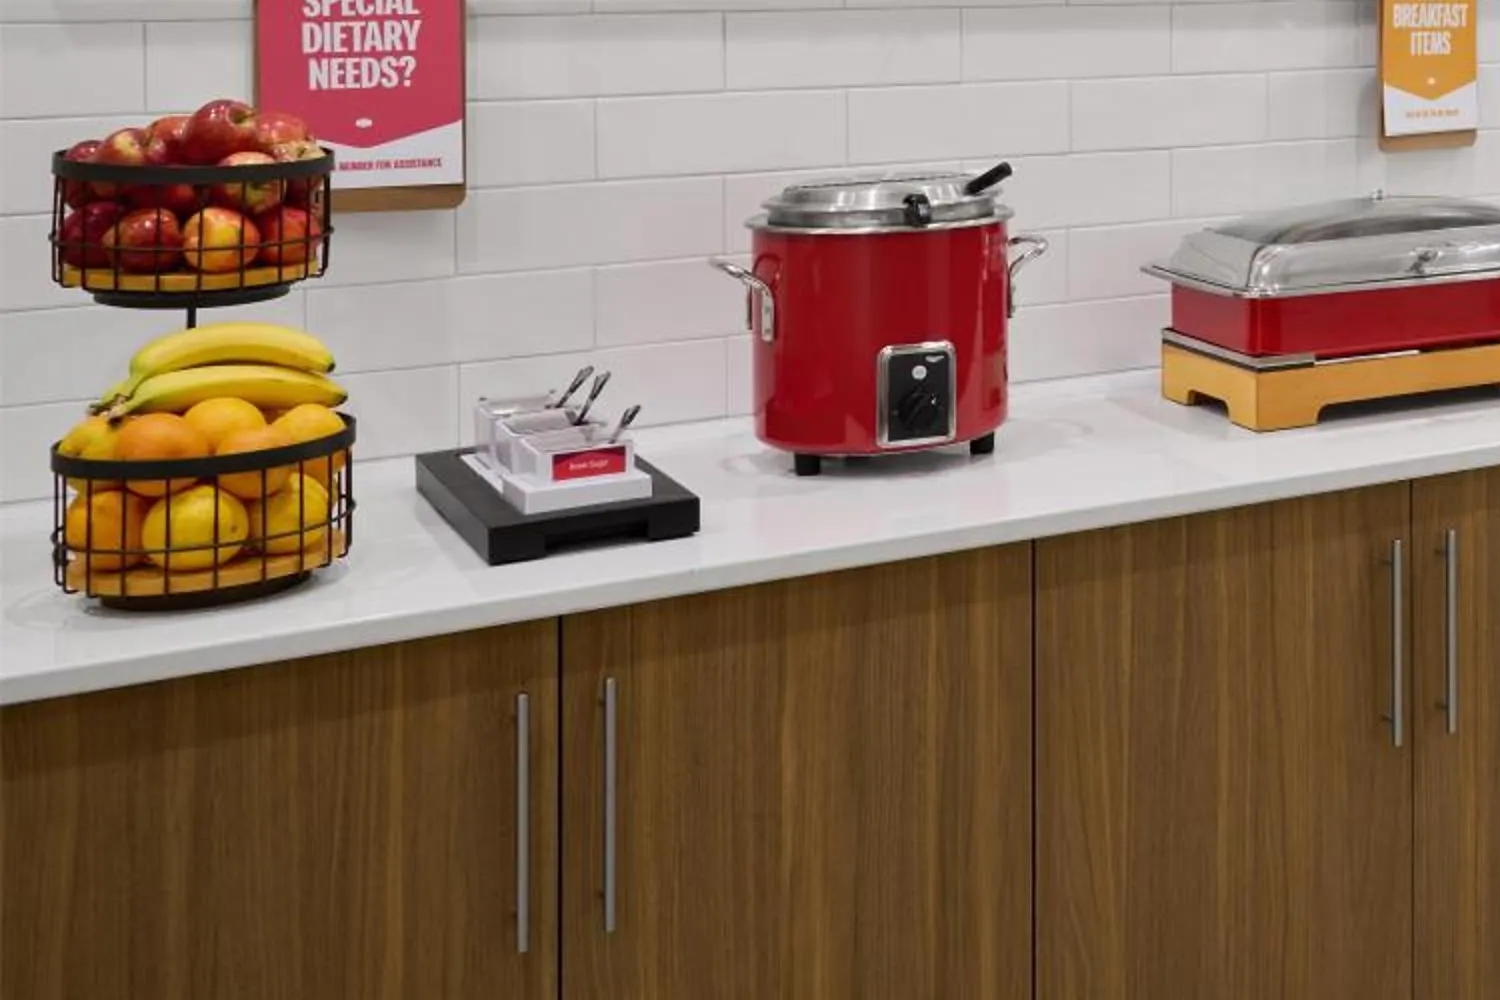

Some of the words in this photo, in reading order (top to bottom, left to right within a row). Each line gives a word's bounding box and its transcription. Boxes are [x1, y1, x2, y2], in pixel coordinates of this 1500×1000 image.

[1392, 2, 1468, 28] BREAKFAST
[302, 19, 421, 54] DIETARY
[1410, 31, 1452, 56] ITEMS
[308, 55, 417, 90] NEEDS?
